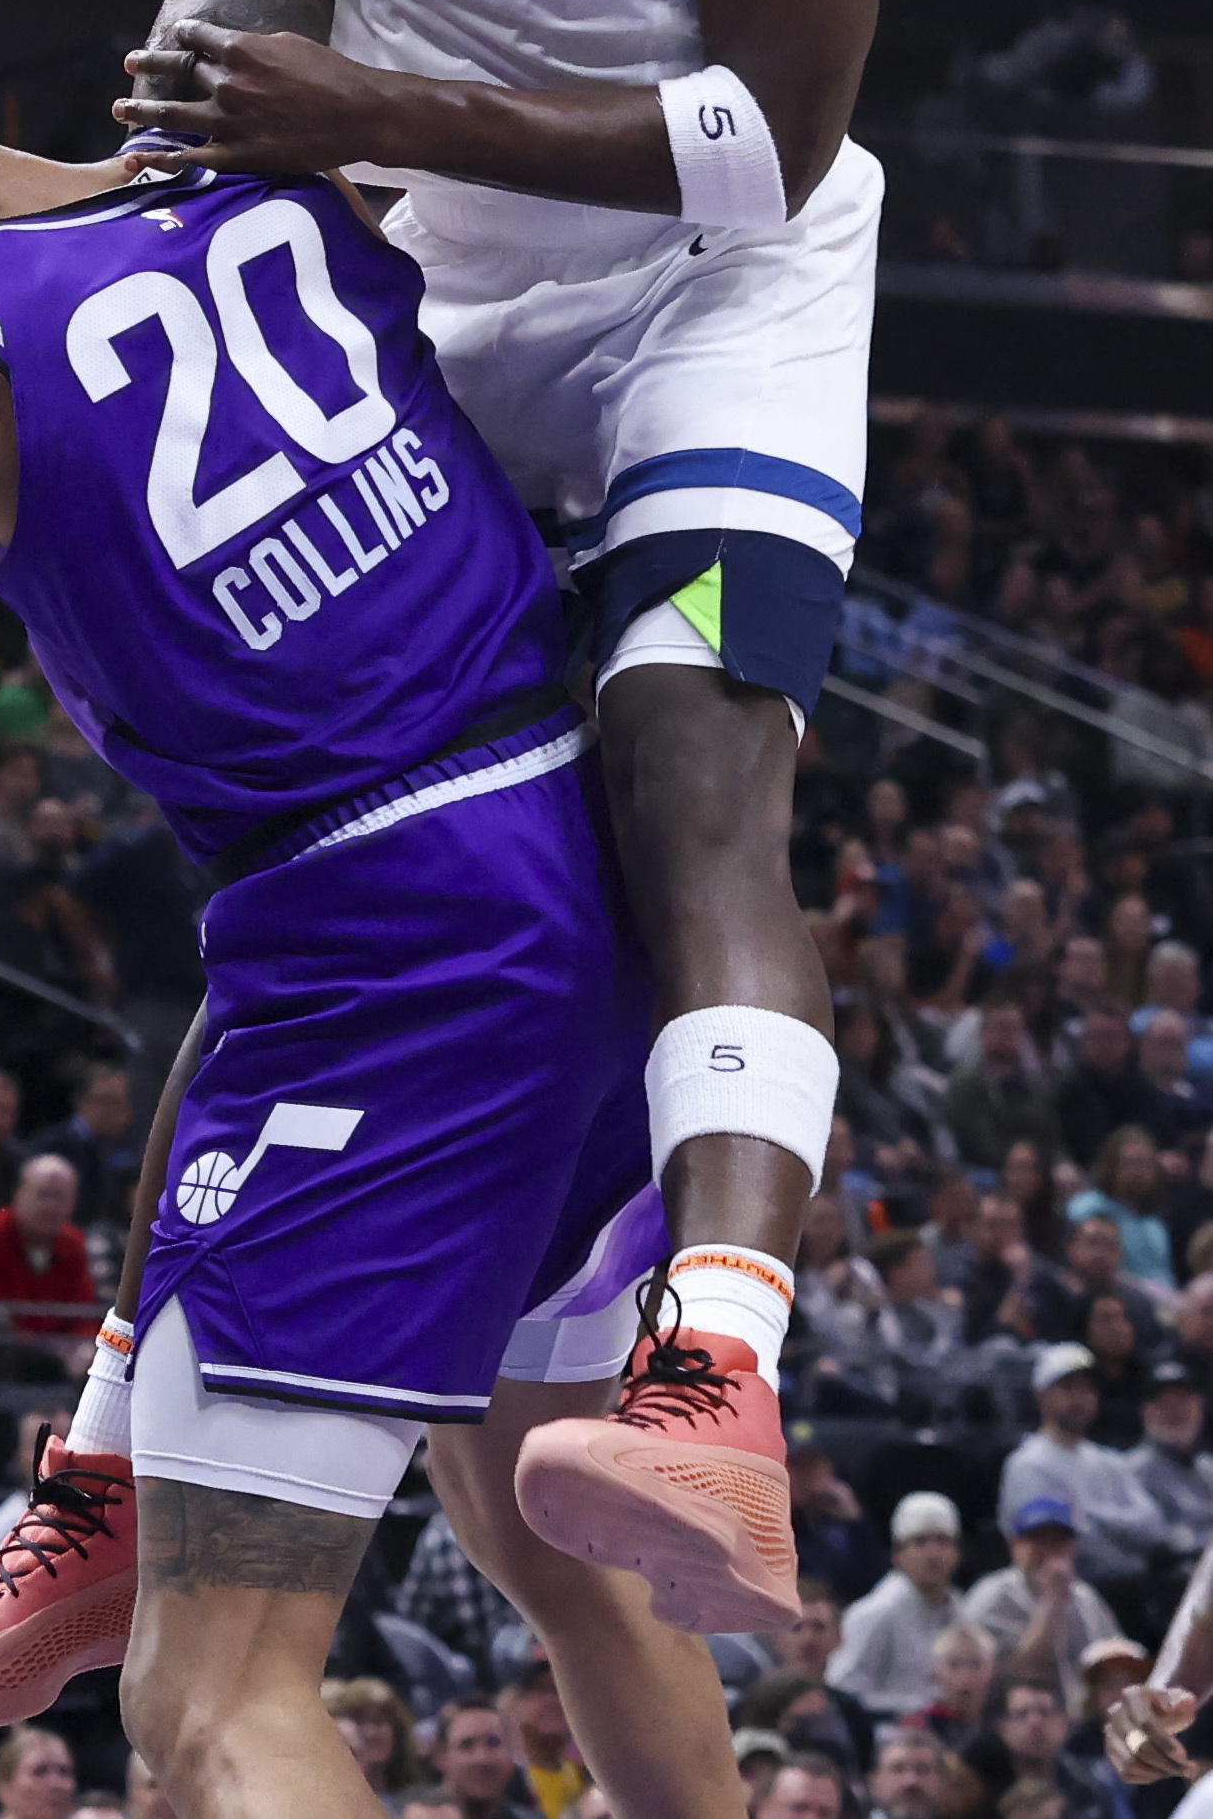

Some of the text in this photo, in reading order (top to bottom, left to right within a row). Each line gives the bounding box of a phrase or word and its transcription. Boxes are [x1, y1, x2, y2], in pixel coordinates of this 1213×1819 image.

[698, 105, 736, 140] 5
[66, 198, 396, 570] 20
[212, 427, 450, 651] COLLINS
[708, 1044, 745, 1072] 5
